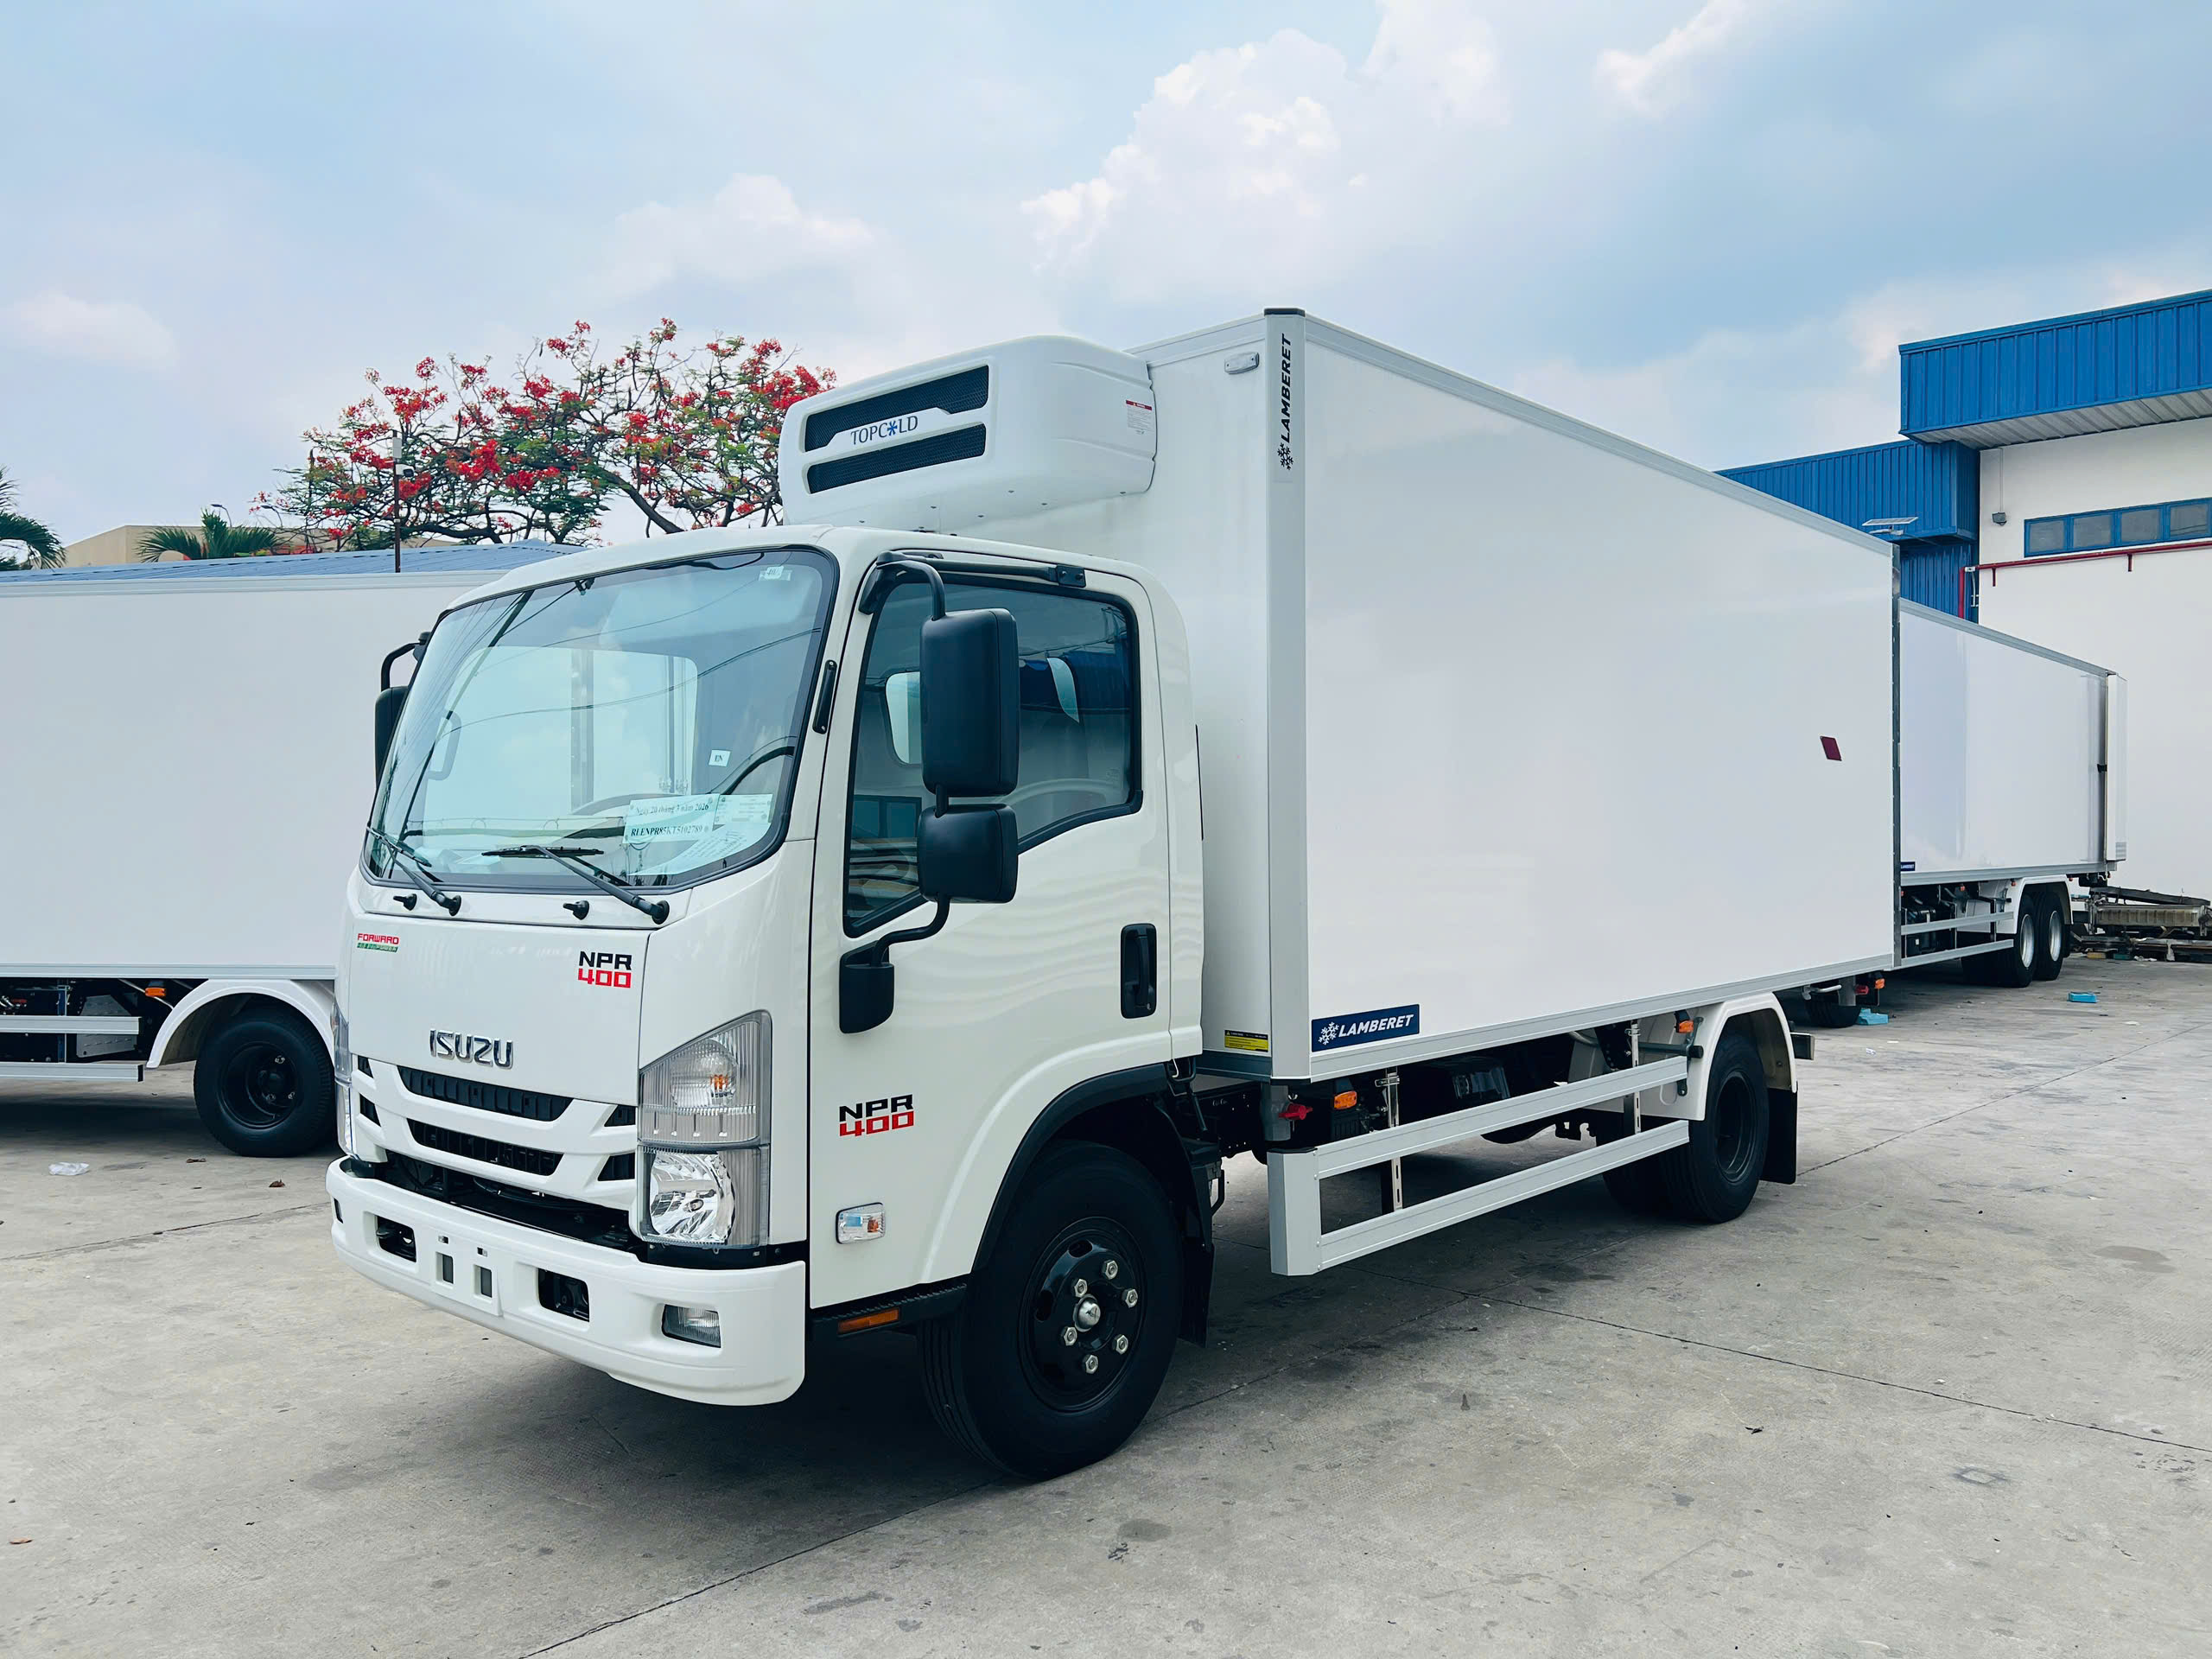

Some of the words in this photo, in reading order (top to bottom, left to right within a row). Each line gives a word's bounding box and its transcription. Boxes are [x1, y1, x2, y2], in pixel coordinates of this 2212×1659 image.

[1281, 333, 1292, 443] LAMBERET
[357, 933, 399, 944] FORWARD
[579, 951, 632, 970] NPR
[578, 968, 631, 988] 400
[1338, 1014, 1414, 1037] LAMBERET
[429, 1028, 513, 1069] ISUZU
[839, 1094, 913, 1122] NPR
[839, 1111, 913, 1136] 400
